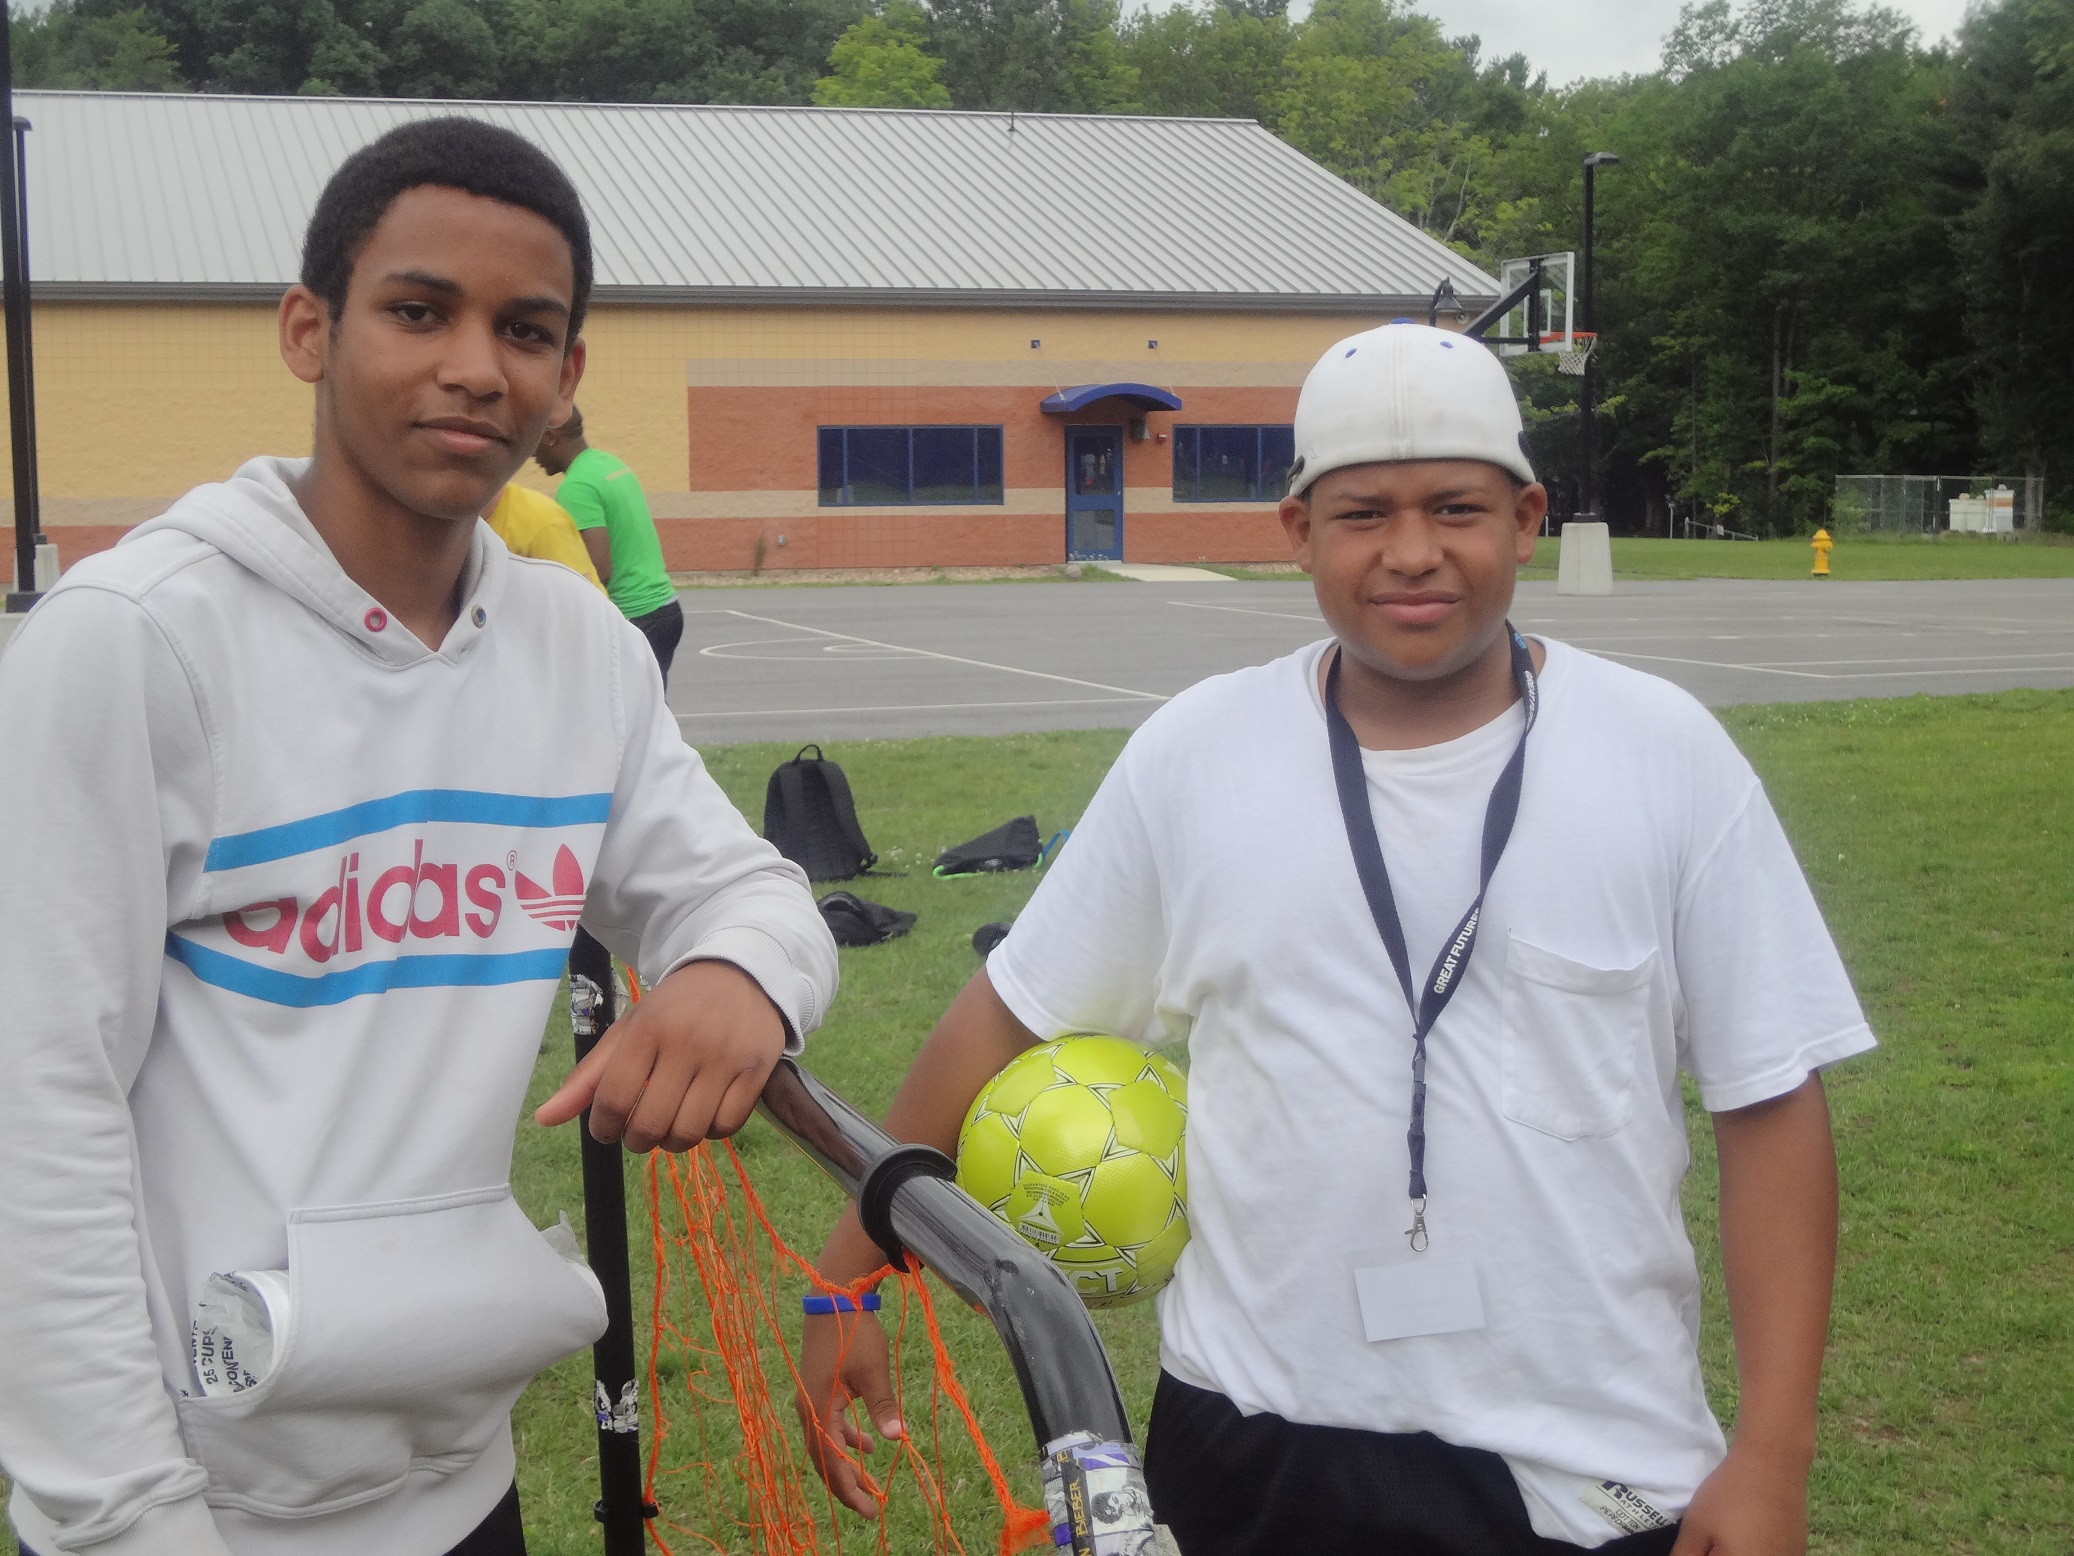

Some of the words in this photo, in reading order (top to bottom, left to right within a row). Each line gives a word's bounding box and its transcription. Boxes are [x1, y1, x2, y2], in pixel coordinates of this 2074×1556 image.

[222, 839, 505, 963] adidas
[1434, 955, 1458, 994] GREAT
[203, 1368, 219, 1385] 25
[1069, 1477, 1089, 1538] BIEBER
[1615, 1508, 1641, 1531] COTTON
[1620, 1499, 1656, 1529] ATHLET
